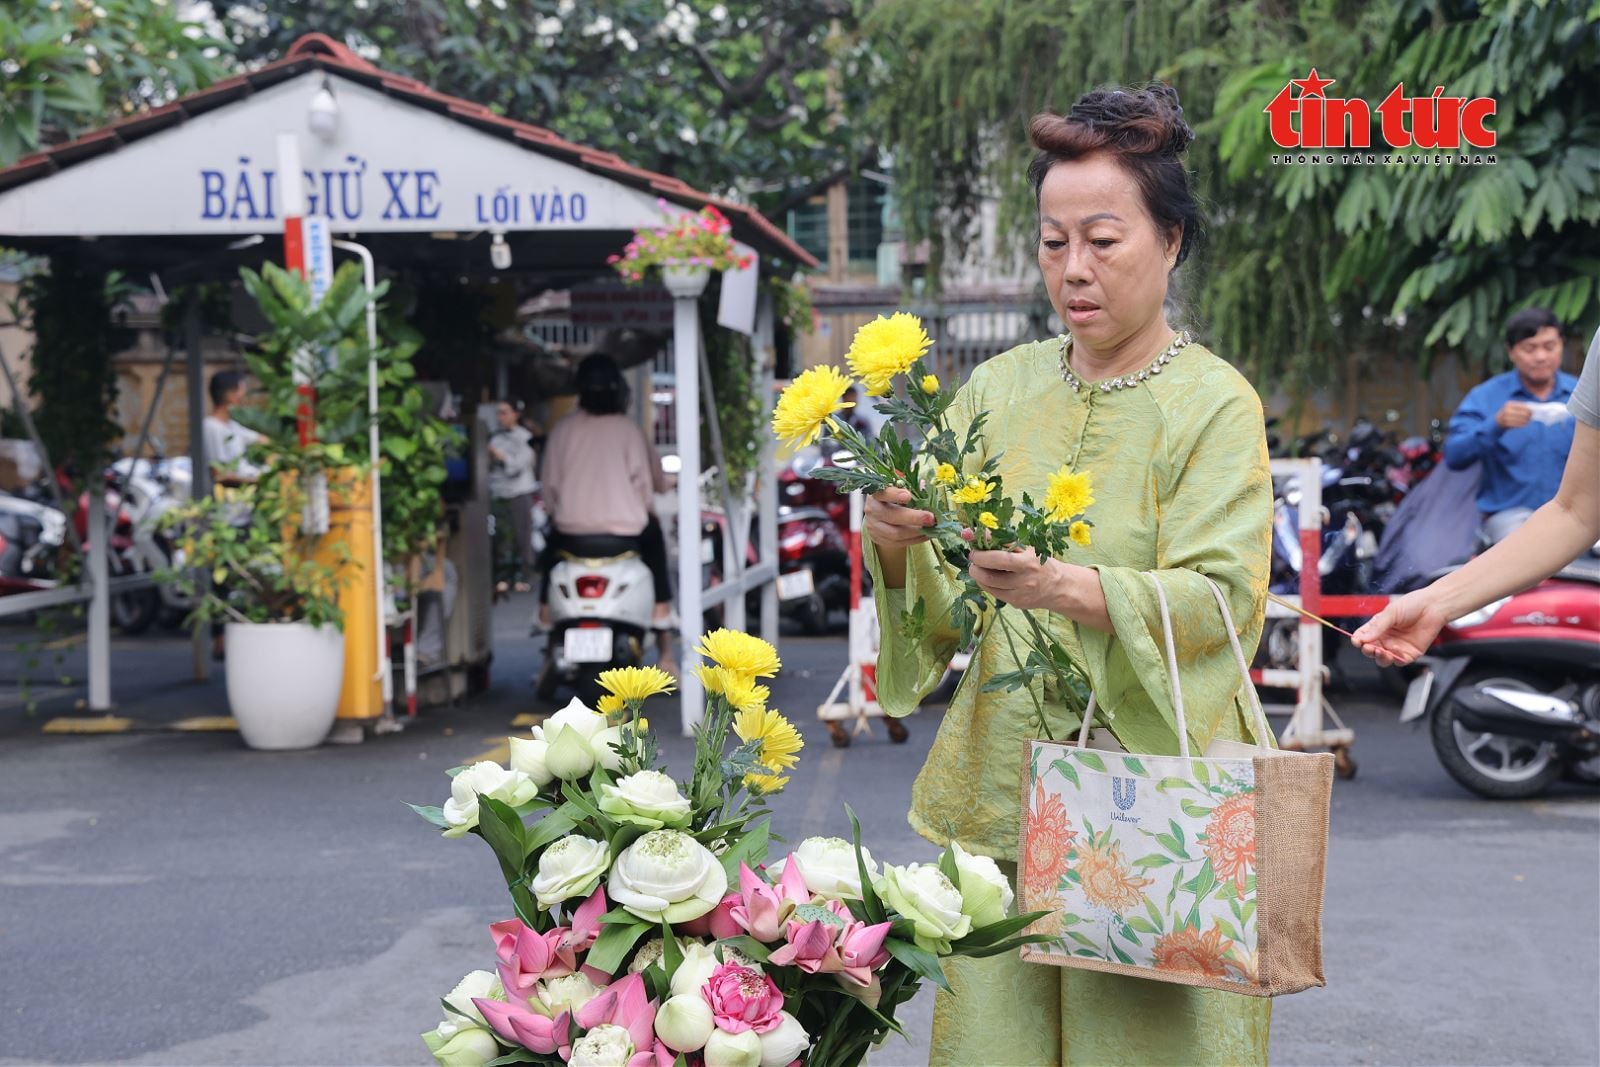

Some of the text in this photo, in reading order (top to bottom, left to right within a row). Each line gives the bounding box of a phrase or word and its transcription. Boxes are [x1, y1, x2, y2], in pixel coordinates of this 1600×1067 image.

[201, 157, 276, 219] BÃI
[382, 171, 442, 219] XE
[477, 184, 586, 223] LỐI VÀO
[1110, 811, 1141, 823] Unilever
